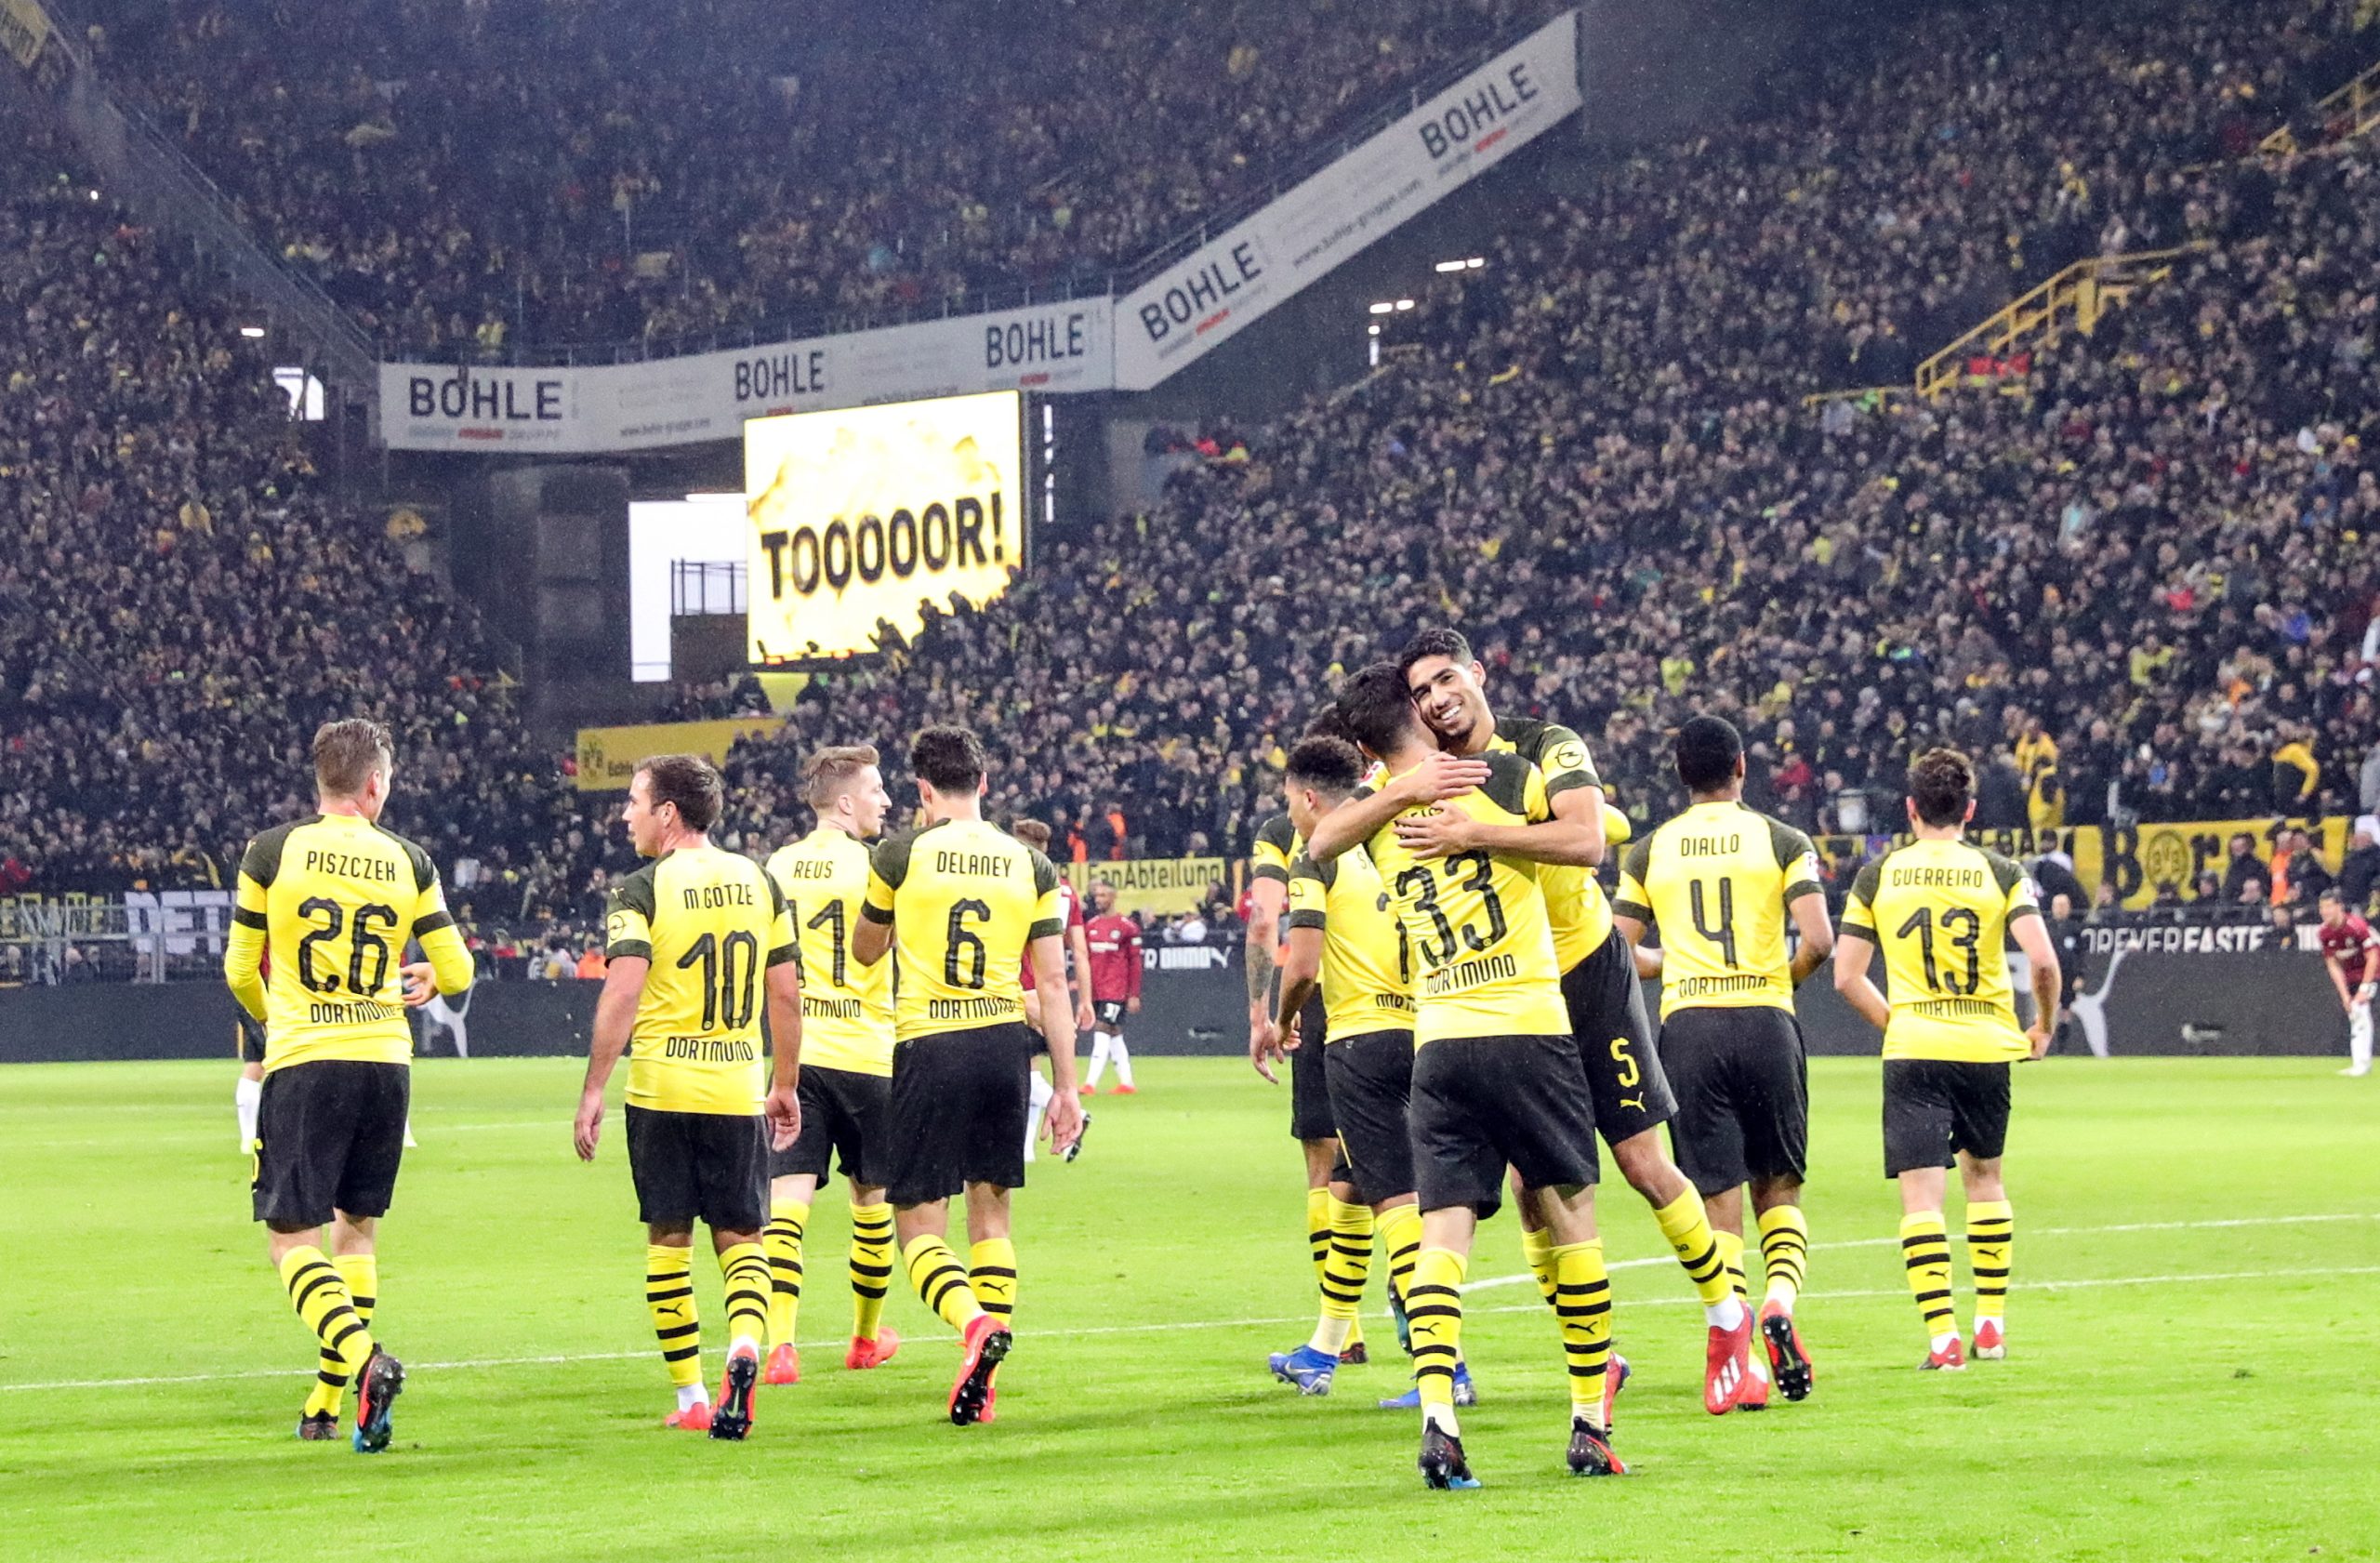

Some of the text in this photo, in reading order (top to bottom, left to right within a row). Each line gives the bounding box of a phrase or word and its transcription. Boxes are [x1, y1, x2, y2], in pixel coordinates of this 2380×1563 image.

[1419, 62, 1540, 160] BOHLE
[1139, 242, 1263, 342] BOHLE
[985, 313, 1084, 368] BOHLE
[409, 376, 563, 420] BOHLE
[734, 351, 826, 401] BOHLE
[760, 491, 1002, 600] TOOOOOR!
[306, 851, 396, 881] PISZCZEK
[793, 860, 834, 879] REUS
[936, 851, 1012, 878] DELANEY
[1680, 834, 1739, 856] DIALLO
[1893, 868, 1983, 888] GUERREIRO
[1395, 849, 1508, 967] 33
[1689, 877, 1739, 971] 4
[298, 896, 398, 998] 26
[945, 897, 991, 989] 6
[1897, 907, 1980, 996] 13
[676, 930, 758, 1030] 10
[802, 998, 861, 1018] RTMUND
[666, 1036, 754, 1062] DORTMUND
[1609, 1037, 1641, 1089] 5
